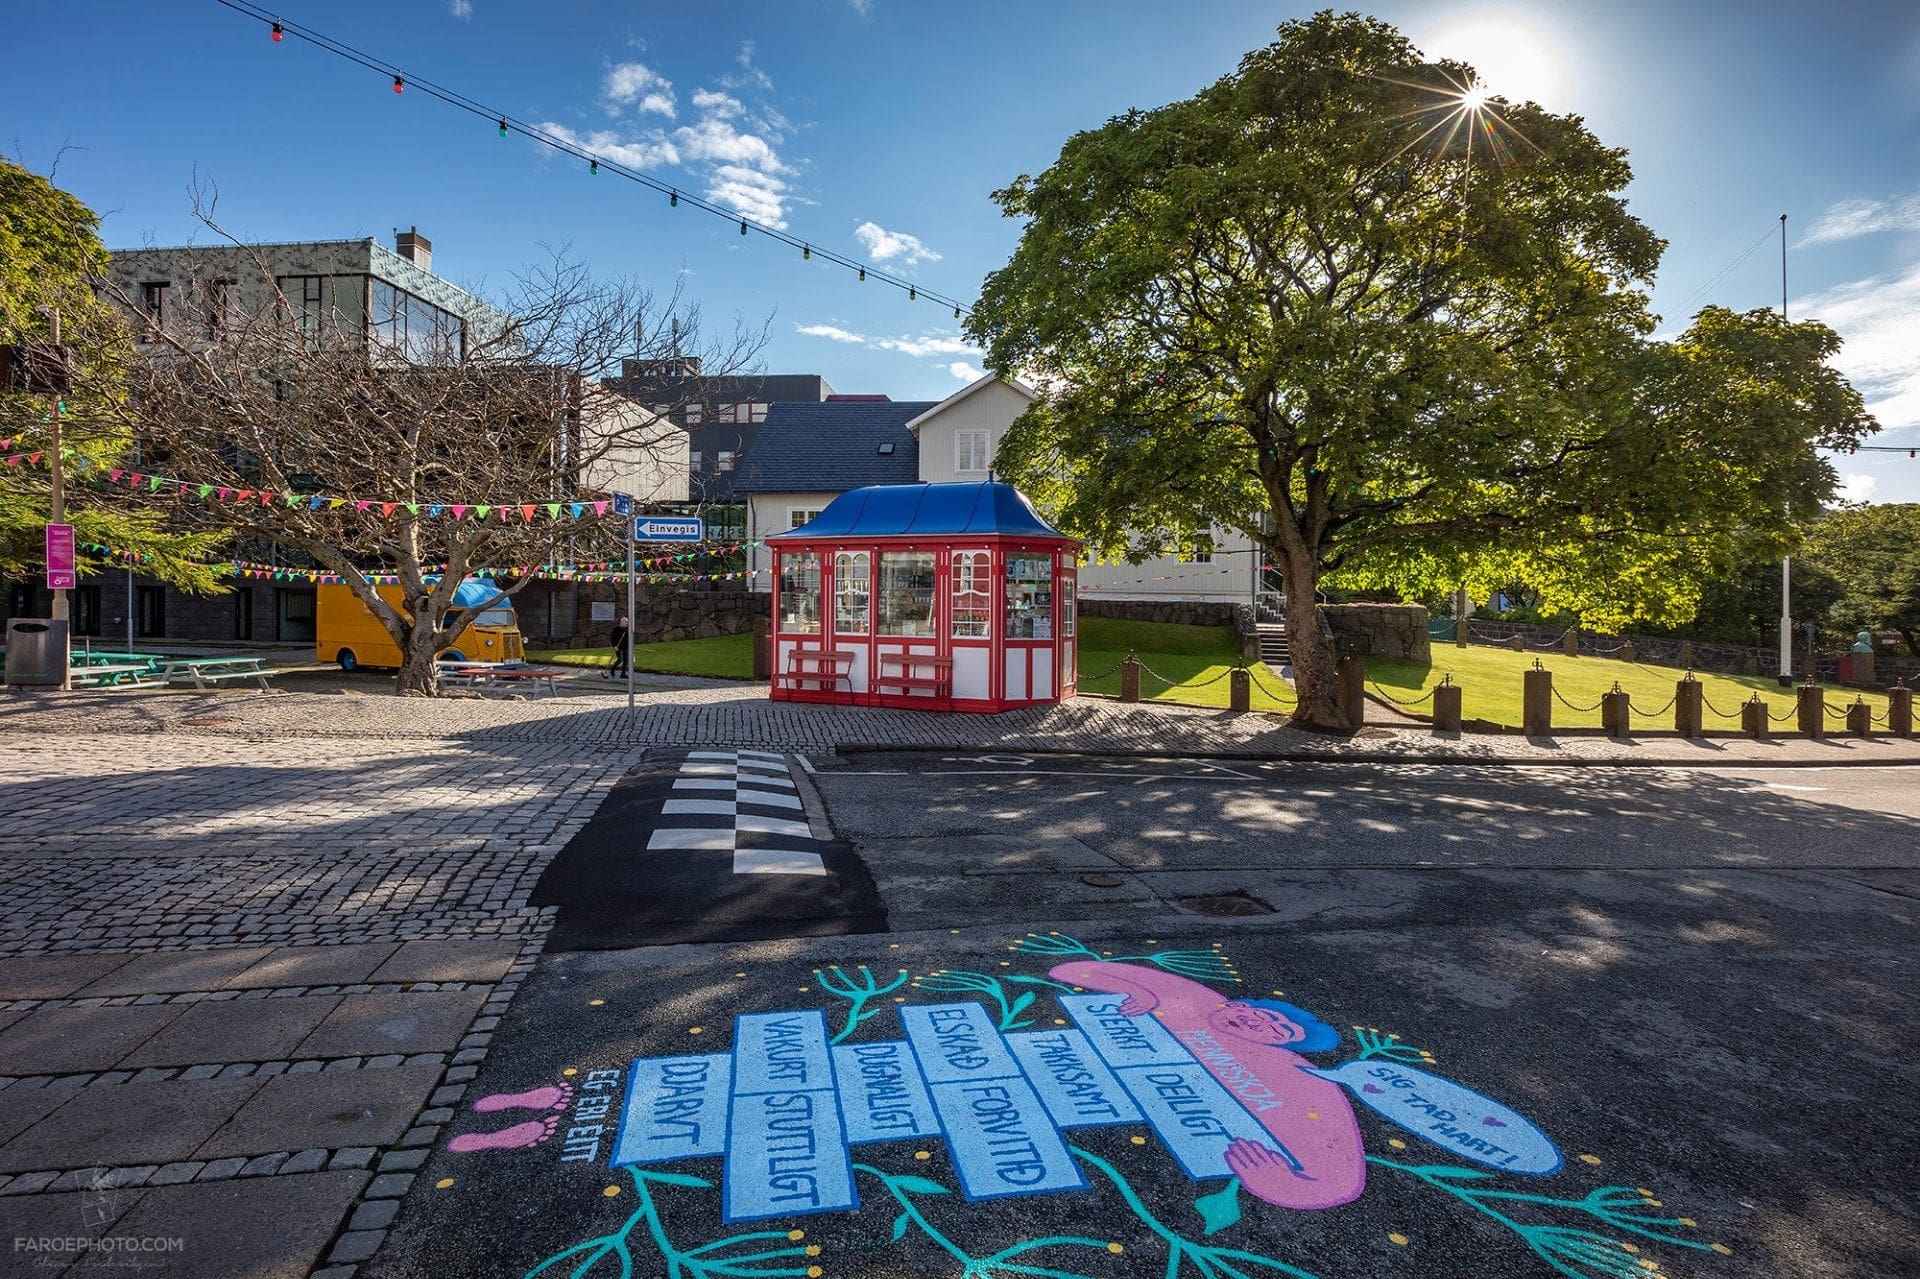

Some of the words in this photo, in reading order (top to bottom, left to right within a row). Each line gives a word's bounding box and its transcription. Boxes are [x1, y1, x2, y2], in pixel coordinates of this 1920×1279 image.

[649, 524, 696, 535] Einvegis
[763, 1016, 807, 1085] VAKURT
[928, 1008, 989, 1070] ELSKAÐ
[582, 1069, 621, 1090] EG
[647, 1060, 711, 1147] DJARVT
[852, 1045, 920, 1135] DUGNALIGT
[1029, 1033, 1121, 1119] TAKKSAMT
[1145, 1072, 1235, 1142] DEILIGT
[1367, 1066, 1419, 1090] SIG
[573, 1095, 613, 1122] ERI
[962, 1084, 1048, 1187] FORVITIÐ
[1400, 1093, 1458, 1126] TAÐ
[560, 1123, 603, 1162] EITT
[763, 1092, 821, 1207] STUTTLIGT
[1428, 1120, 1522, 1166] HART!
